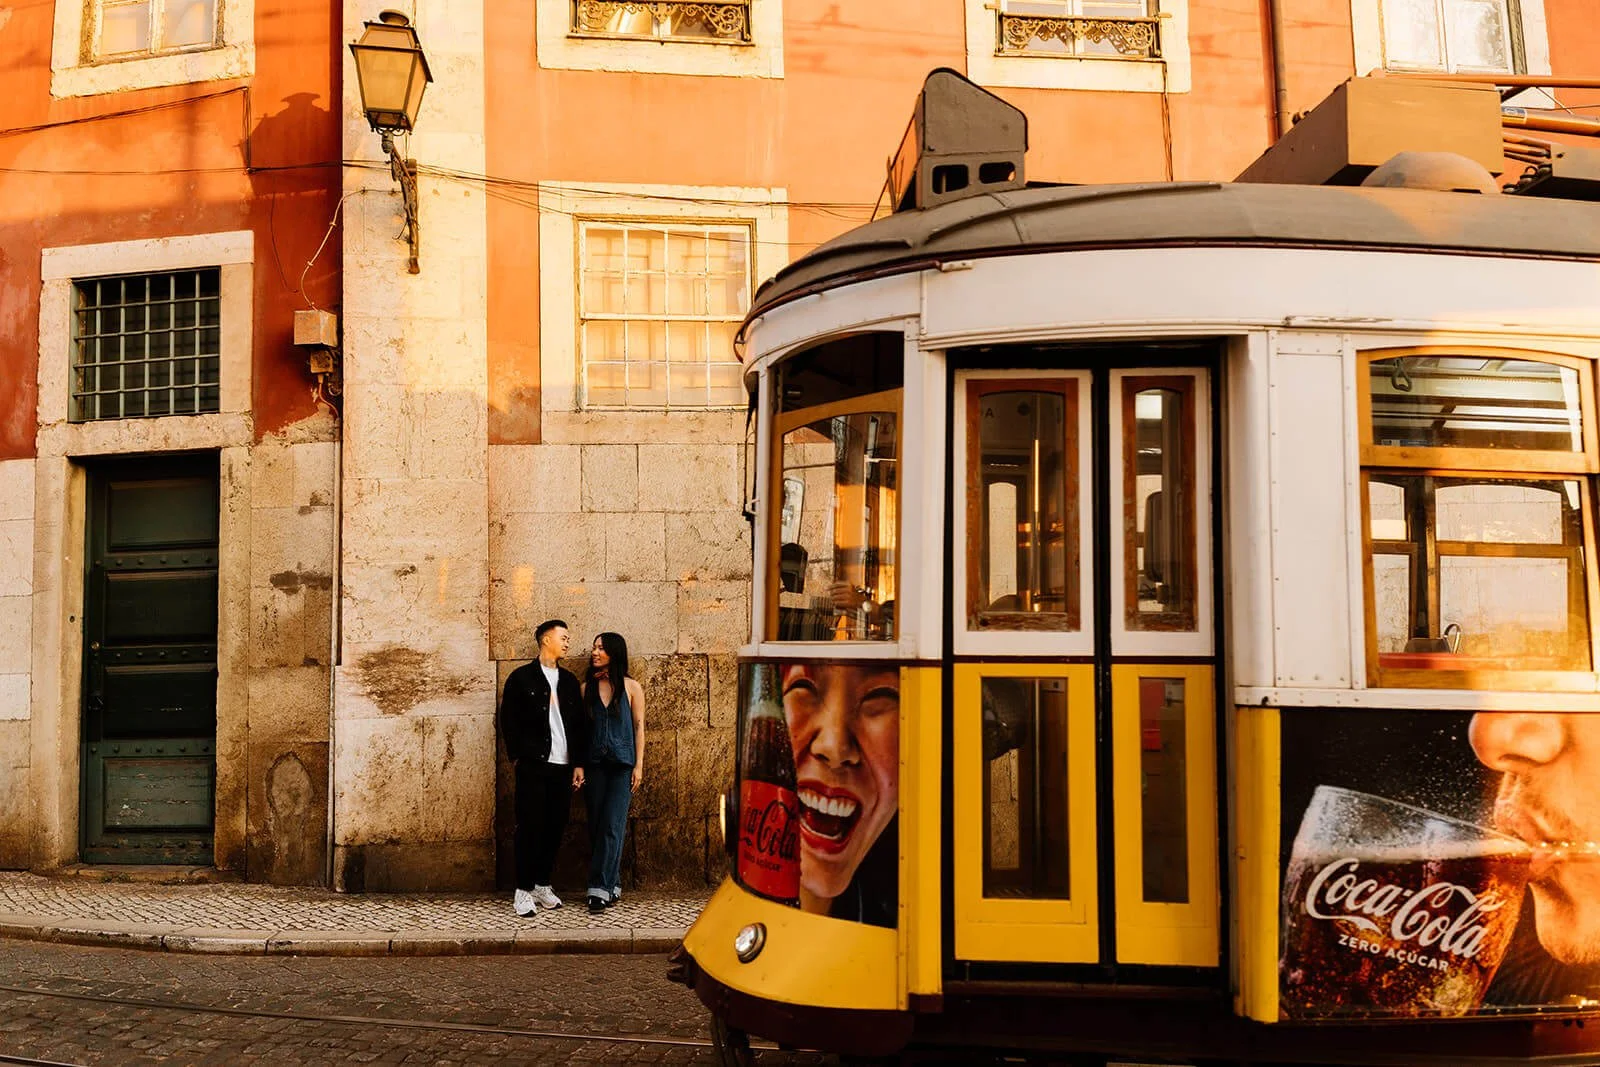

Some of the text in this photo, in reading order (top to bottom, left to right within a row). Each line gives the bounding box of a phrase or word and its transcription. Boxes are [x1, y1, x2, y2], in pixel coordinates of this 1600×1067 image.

[1305, 857, 1507, 959] Coca-Cola
[1338, 933, 1449, 972] ZERO AÇÚCAR
